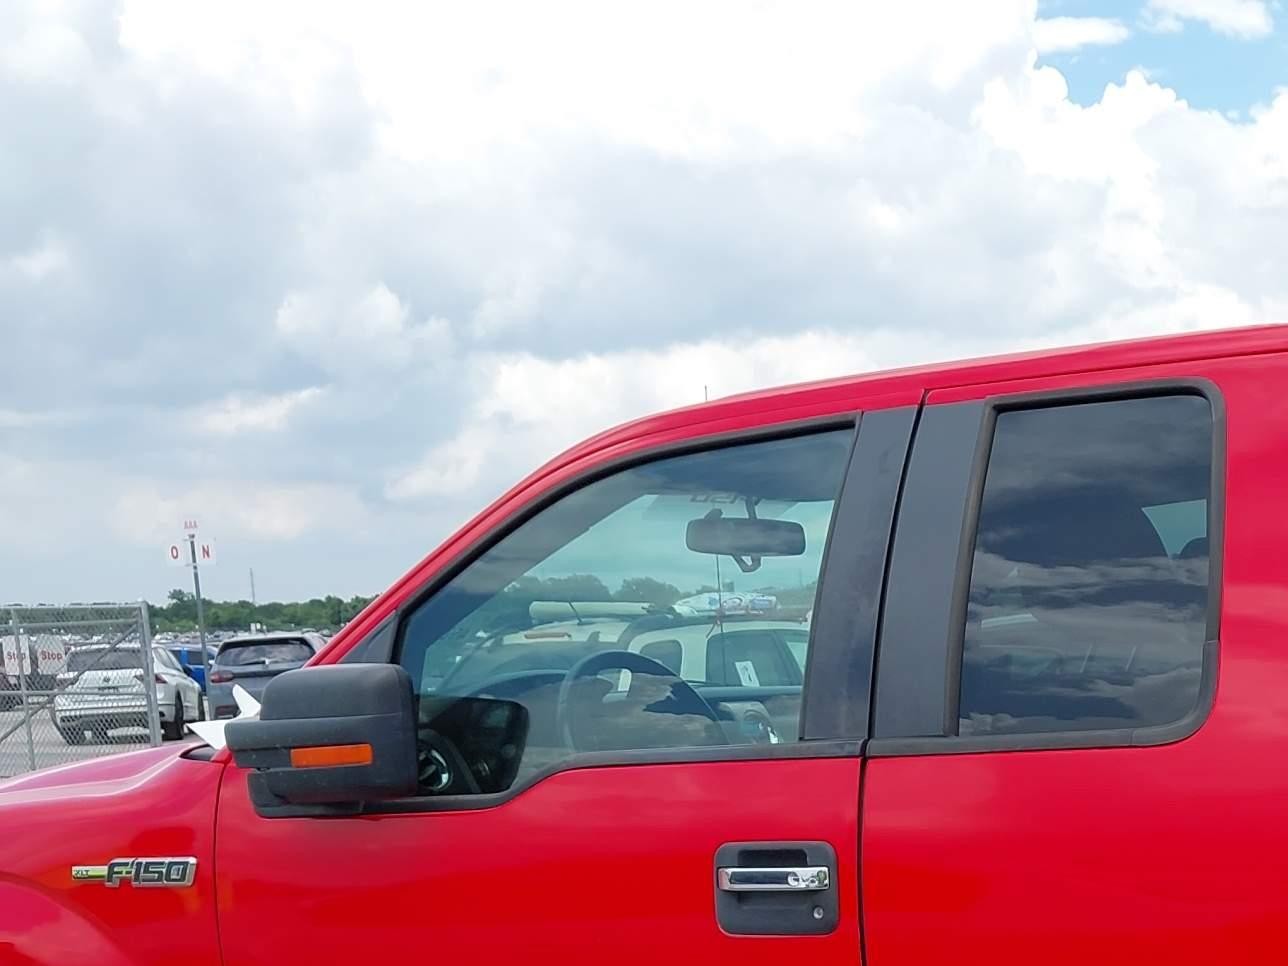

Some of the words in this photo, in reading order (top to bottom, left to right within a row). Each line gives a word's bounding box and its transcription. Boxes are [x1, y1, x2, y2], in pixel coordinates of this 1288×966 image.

[170, 545, 179, 560] O
[202, 545, 210, 559] N
[7, 650, 26, 661] Stp
[41, 649, 63, 661] Stop
[74, 869, 90, 877] XLT
